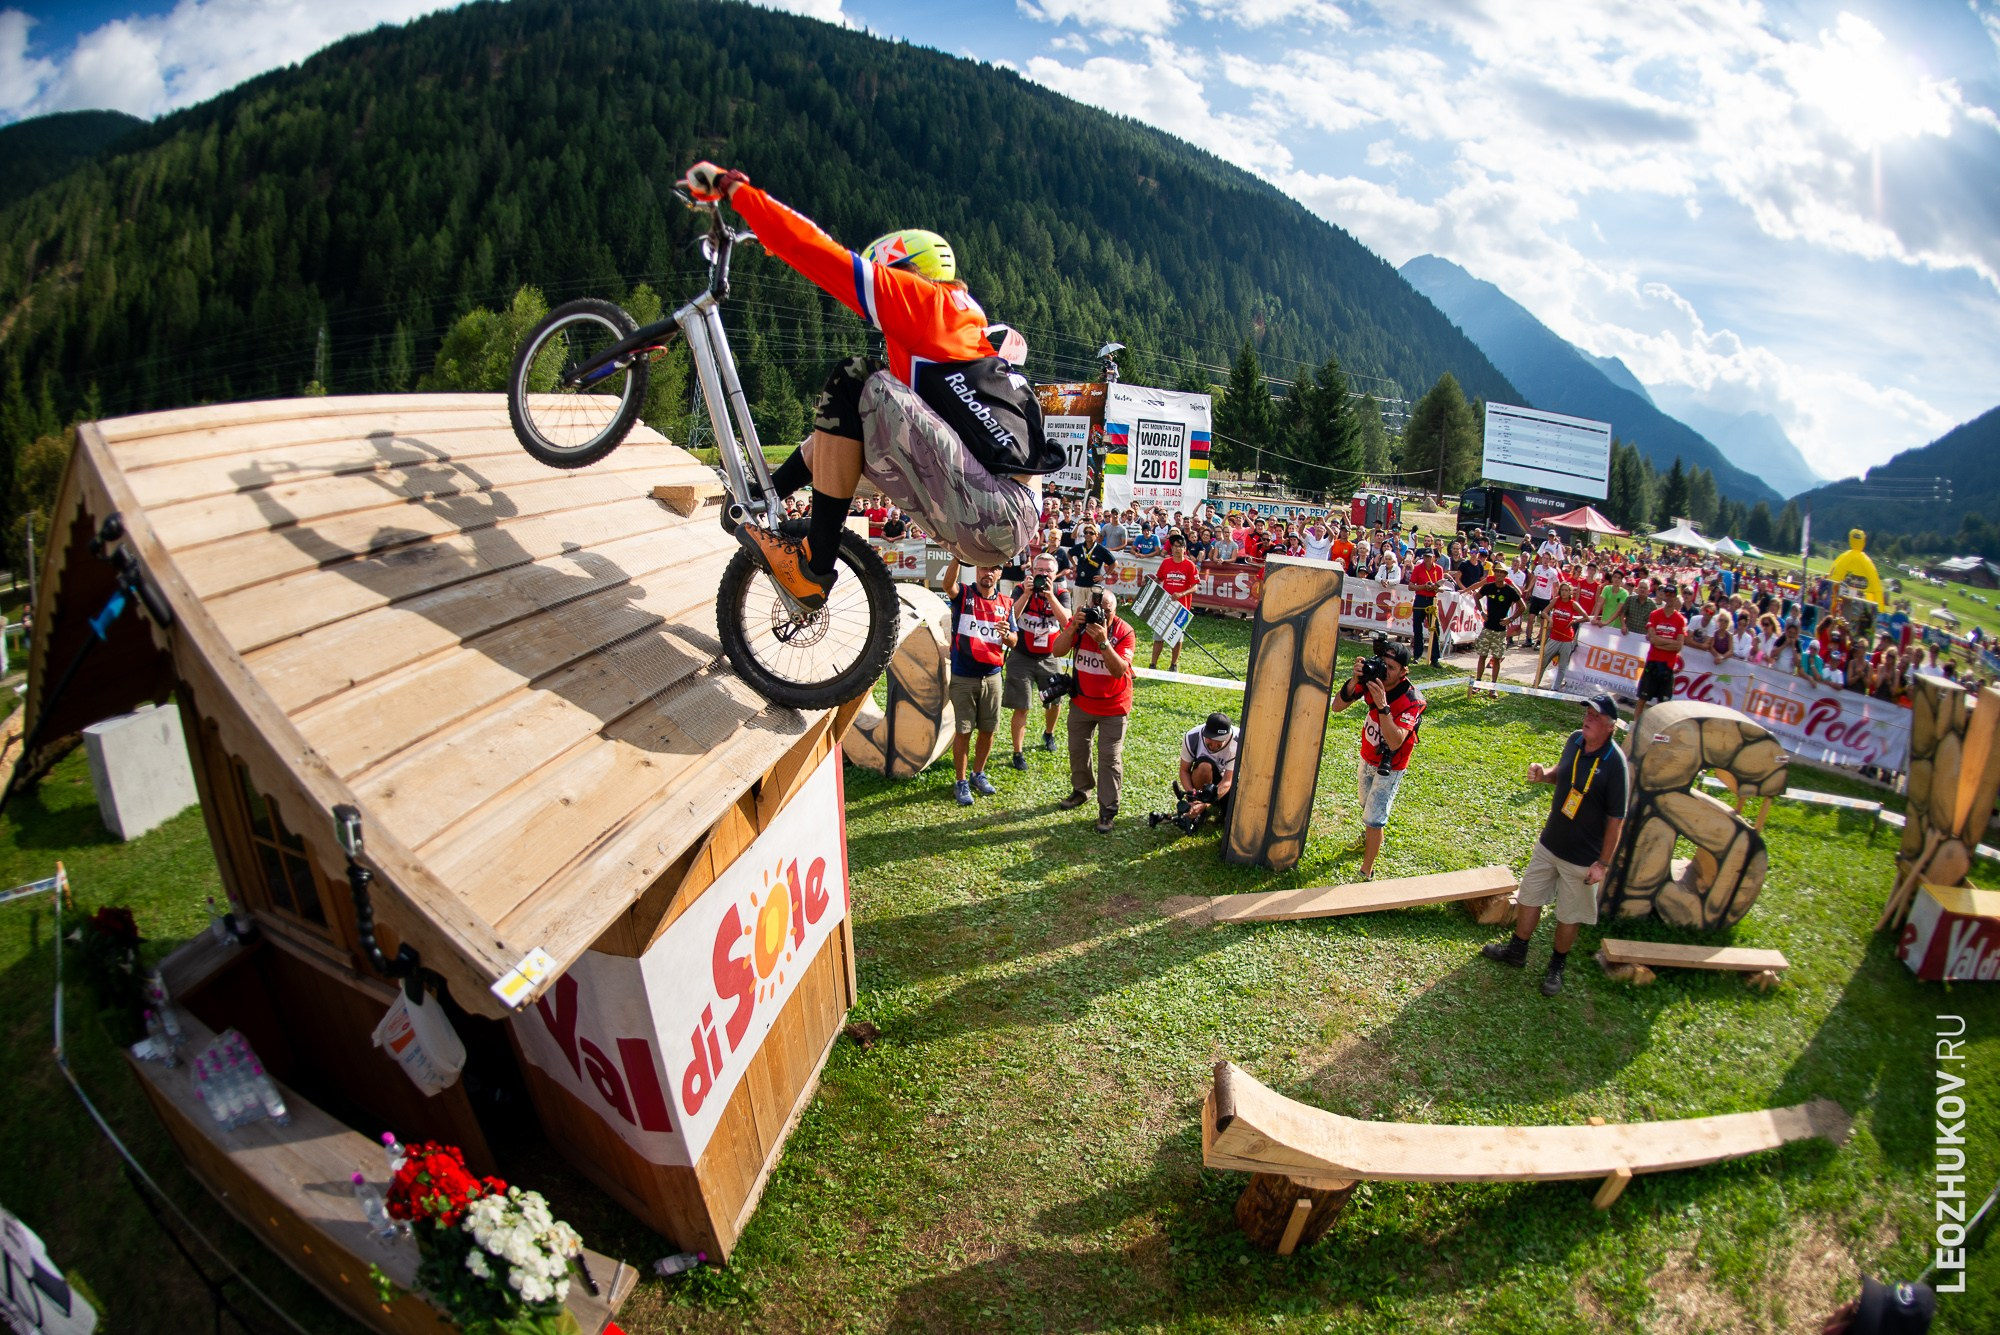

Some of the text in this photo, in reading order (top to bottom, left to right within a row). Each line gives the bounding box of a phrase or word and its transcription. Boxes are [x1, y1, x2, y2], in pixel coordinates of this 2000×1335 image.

[944, 372, 1014, 447] Rabobank
[1054, 422, 1076, 430] MOUNTAIN
[1141, 431, 1180, 448] WORLD
[1066, 444, 1084, 468] 17
[1141, 449, 1179, 458] CHAMPIONSHIPS
[1141, 458, 1178, 480] 2016
[1163, 488, 1182, 498] TRIALS
[1525, 495, 1548, 505] WATCH
[1257, 503, 1280, 514] PEJO
[927, 550, 954, 561] FINIS
[1216, 582, 1233, 598] di
[1354, 601, 1373, 620] di
[1437, 599, 1473, 634] Val di
[1076, 654, 1105, 669] PHOT
[1587, 647, 1639, 678] IPER
[1750, 691, 1799, 723] IPER
[535, 970, 673, 1133] Val
[682, 1002, 724, 1117] di
